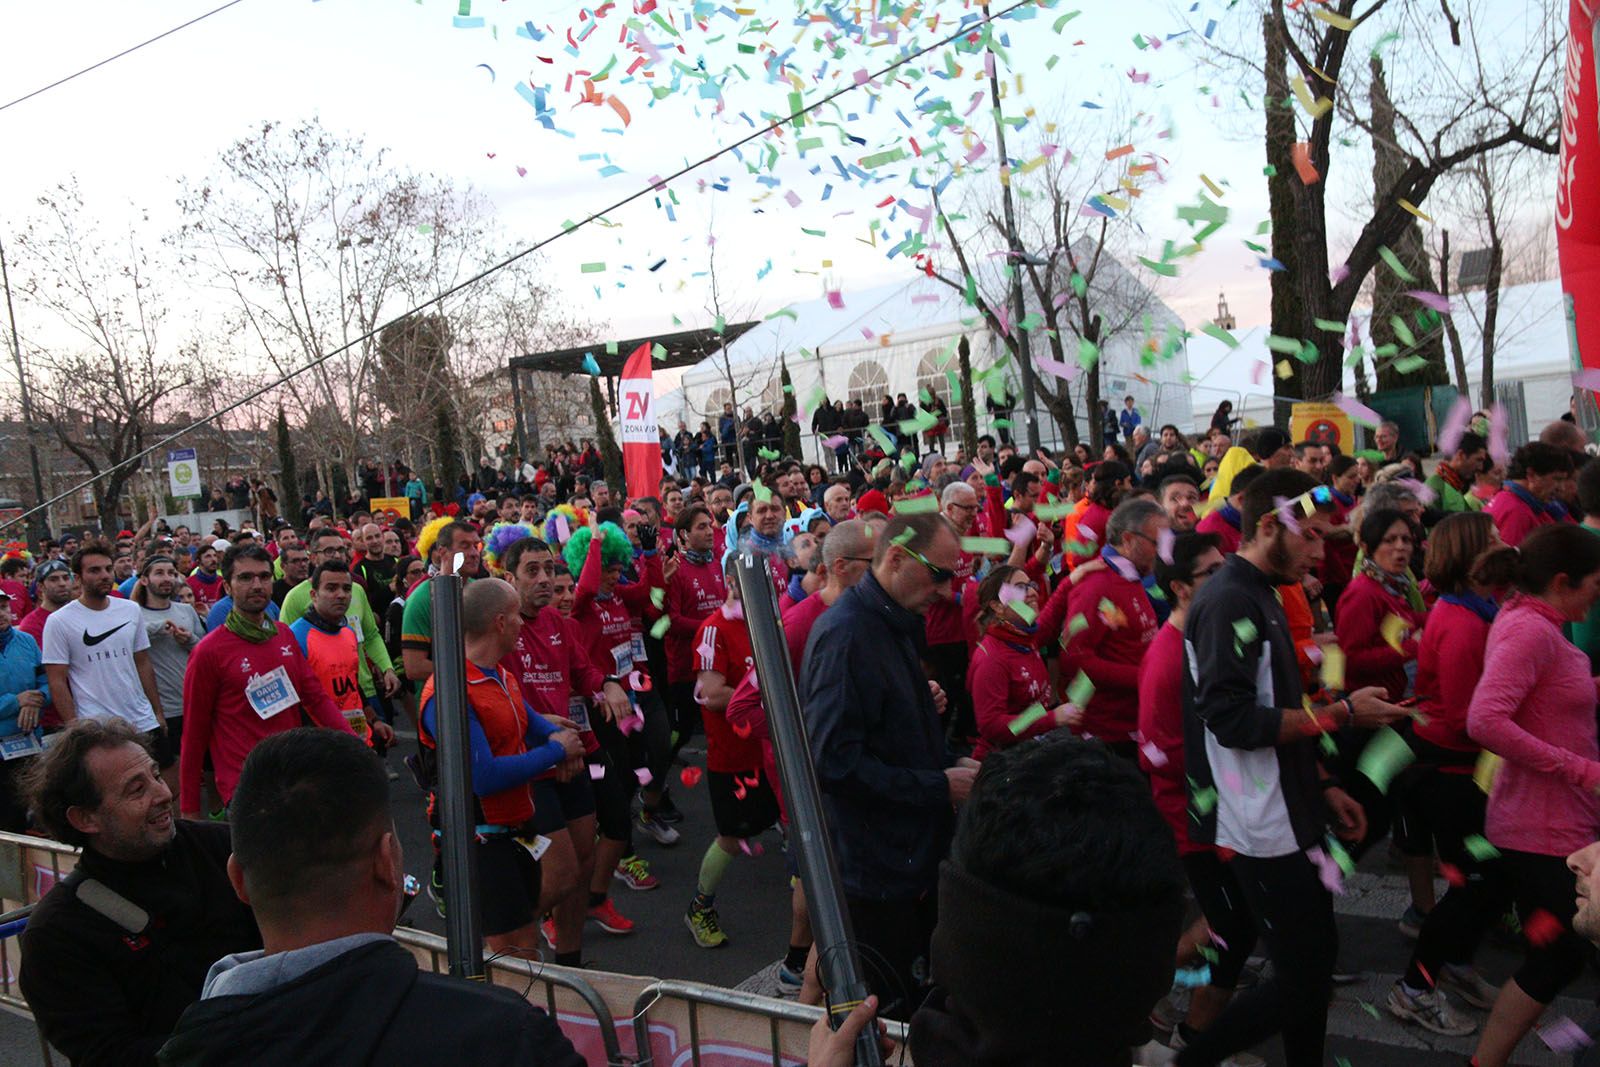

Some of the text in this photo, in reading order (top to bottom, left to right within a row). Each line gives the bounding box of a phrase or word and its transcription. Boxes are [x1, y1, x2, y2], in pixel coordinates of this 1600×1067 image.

[625, 425, 657, 433] ZONA VIP
[255, 681, 279, 698] DAVID
